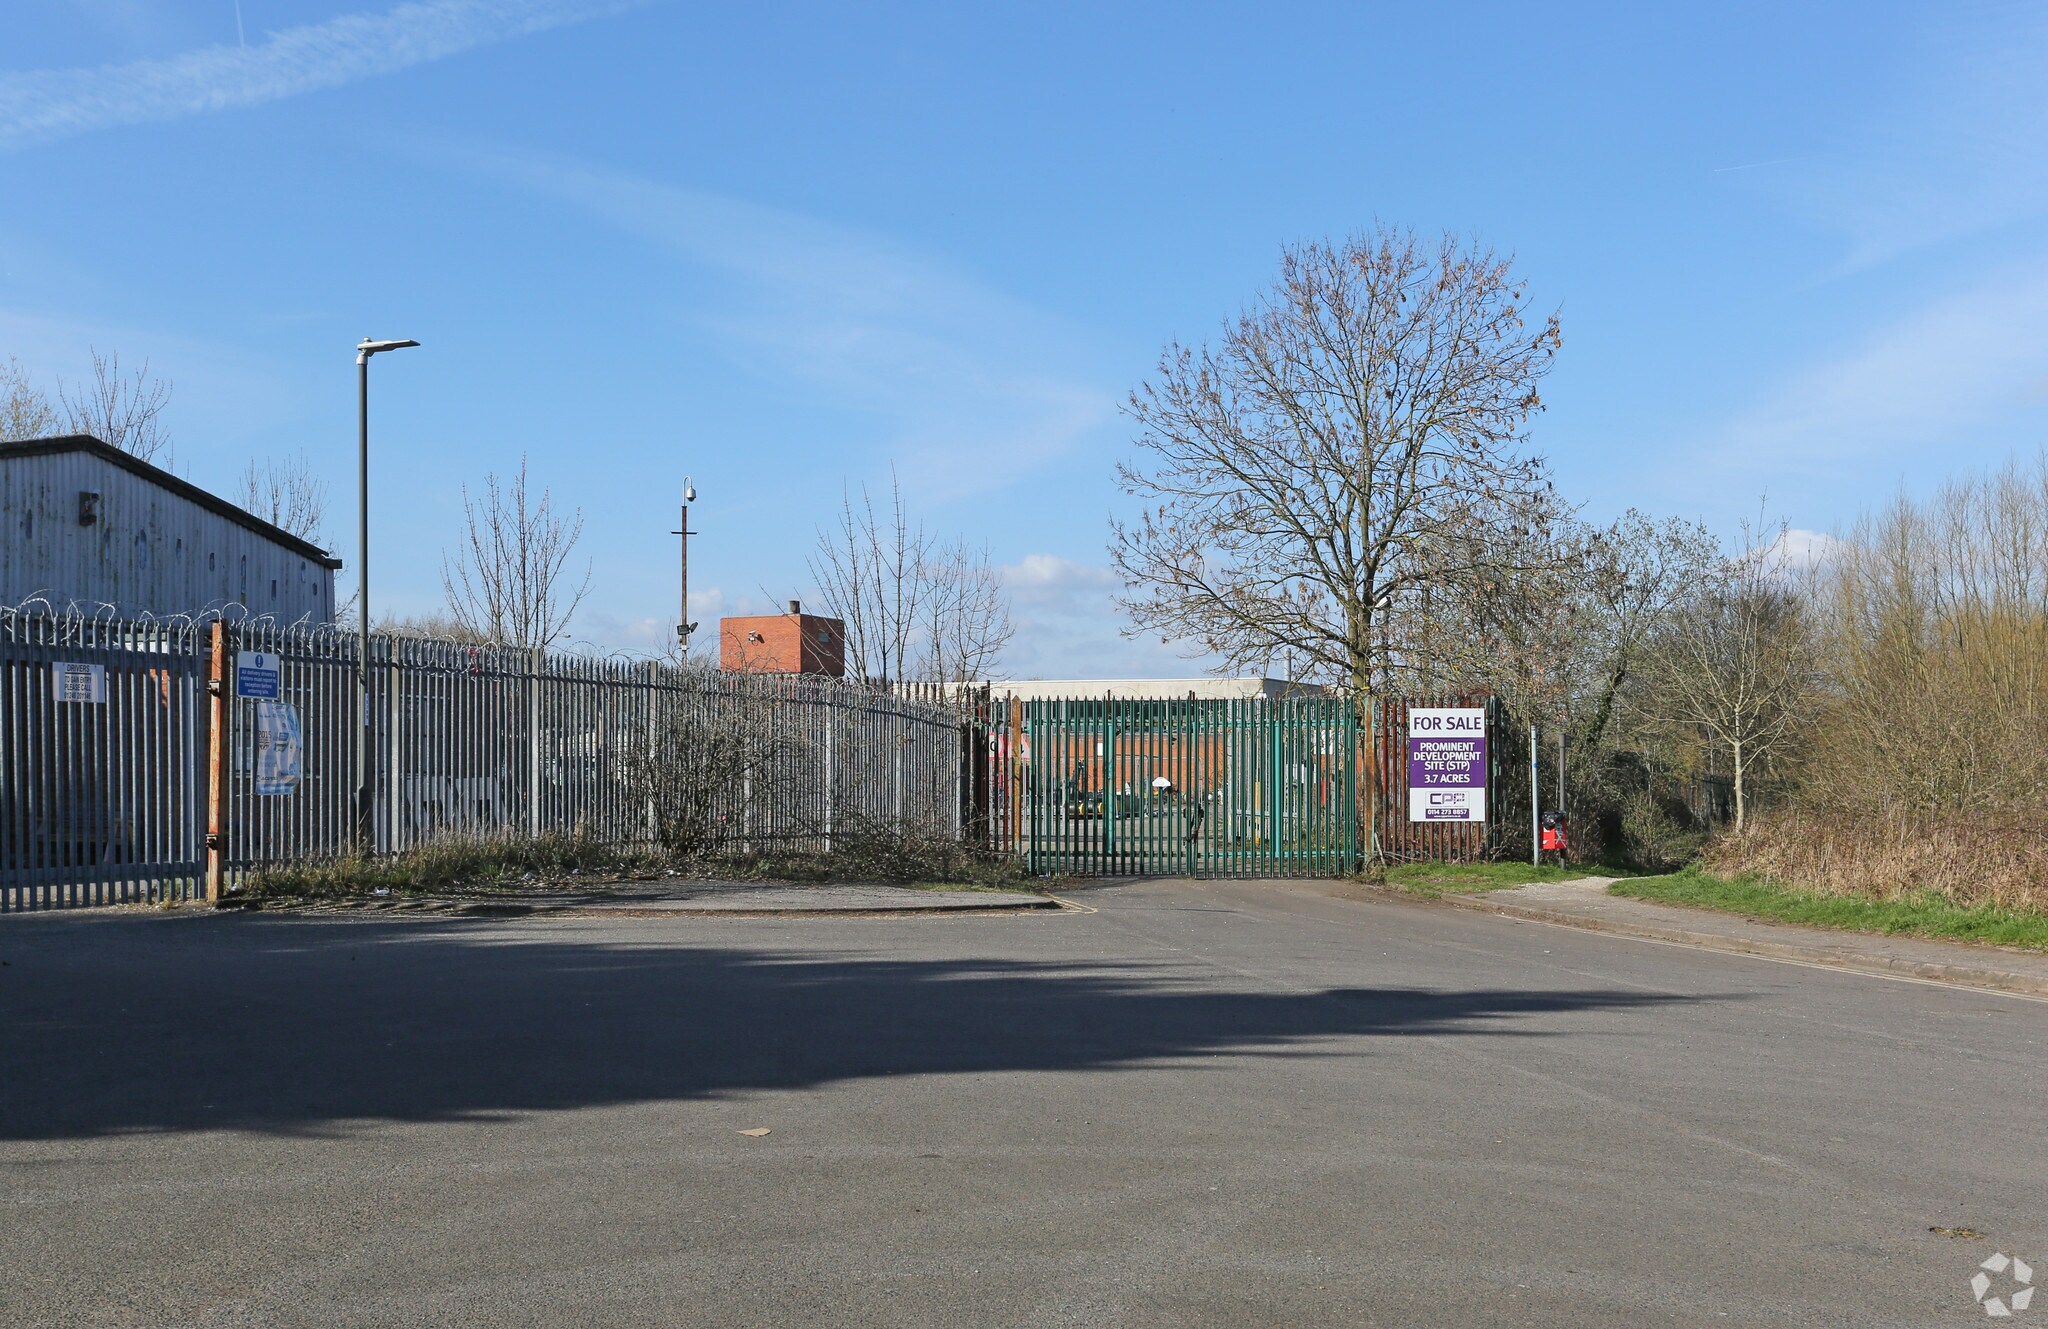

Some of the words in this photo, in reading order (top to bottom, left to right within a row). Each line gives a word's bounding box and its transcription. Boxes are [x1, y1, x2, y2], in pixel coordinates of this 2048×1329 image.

[67, 664, 90, 672] DRIVERS
[71, 676, 80, 684] GAIN
[80, 676, 92, 684] ENTRY
[81, 684, 91, 692] CALL
[1414, 717, 1442, 730] FOR
[1446, 717, 1482, 730] SALE
[1420, 742, 1475, 751] PROMINENT
[1414, 752, 1481, 761] DEVELOPMENT
[1425, 761, 1445, 770] SITE
[1446, 760, 1471, 772] (STP)
[1425, 774, 1438, 784] 3.7
[1440, 774, 1471, 783] ACRES
